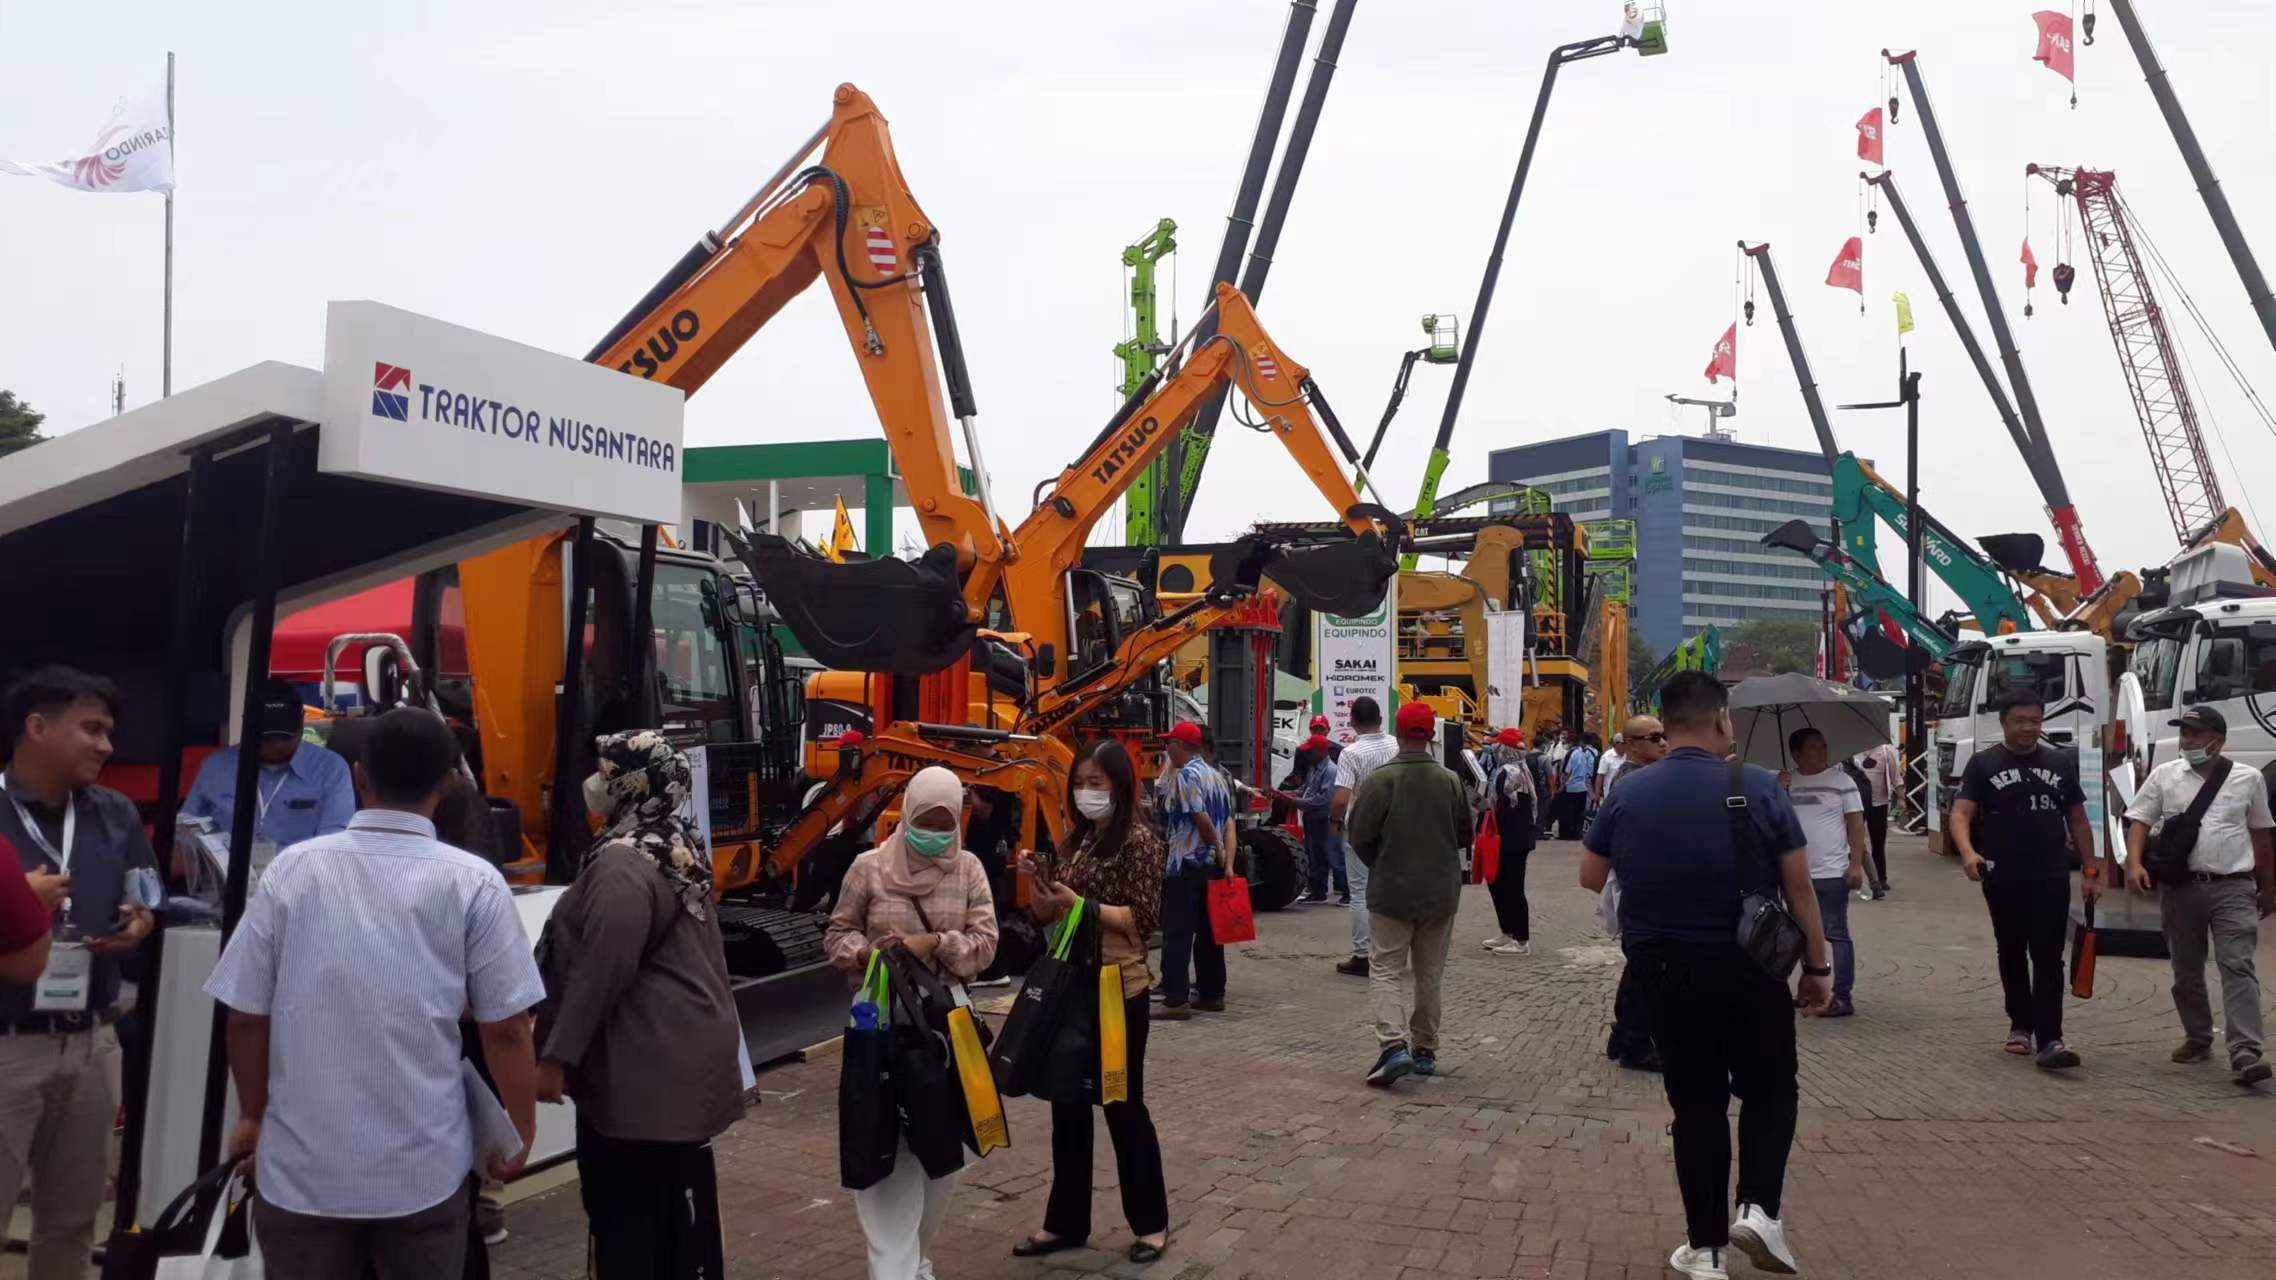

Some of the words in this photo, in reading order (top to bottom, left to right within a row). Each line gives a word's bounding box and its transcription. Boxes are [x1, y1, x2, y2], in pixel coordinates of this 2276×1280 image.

[418, 384, 542, 443] TRAKTOR
[549, 416, 675, 473] NUSANTARA
[1092, 416, 1158, 484] TATSUO
[1324, 628, 1386, 638] EQUIPINDO
[1335, 659, 1376, 669] SAKAI
[1346, 687, 1376, 695] EUROTEC
[1989, 768, 2021, 790] NEW
[2028, 767, 2062, 789] ORK
